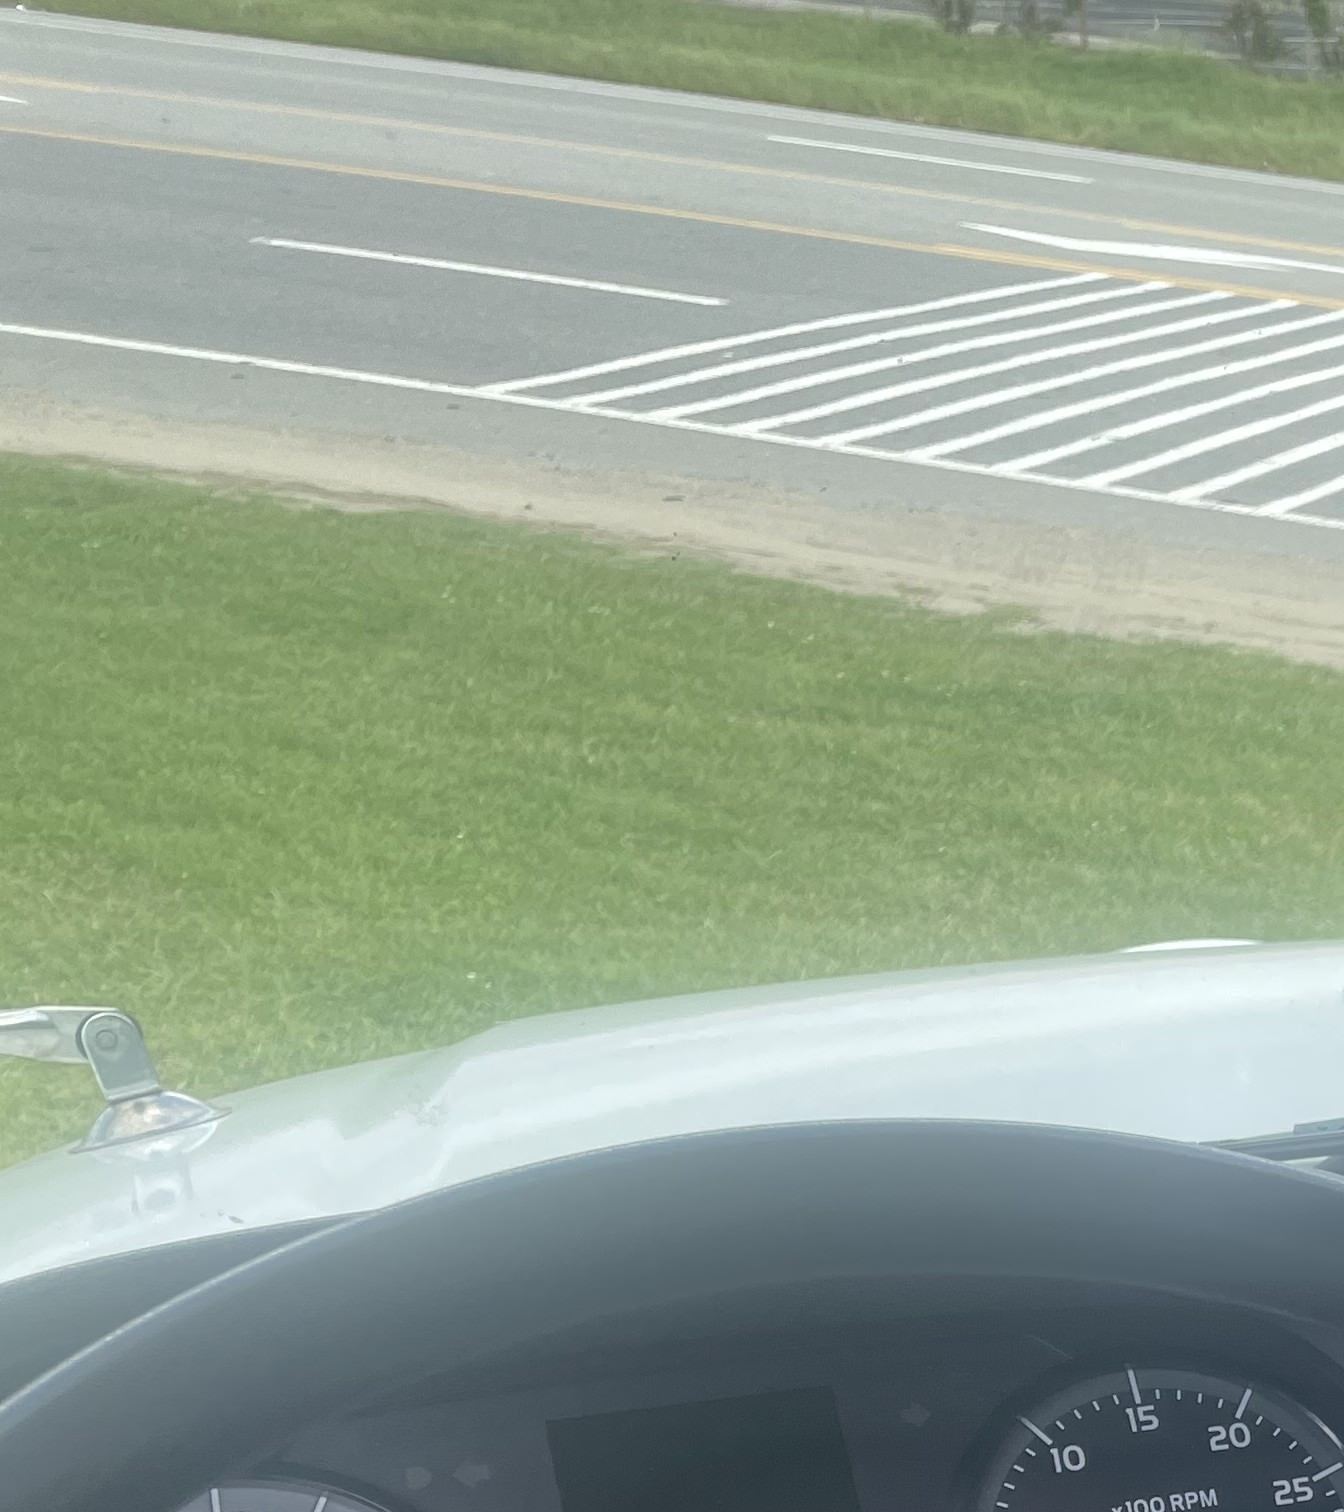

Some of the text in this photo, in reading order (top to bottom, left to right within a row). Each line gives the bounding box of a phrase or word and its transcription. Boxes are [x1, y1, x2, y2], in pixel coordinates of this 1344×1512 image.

[1126, 1403, 1160, 1433] 15
[1208, 1422, 1252, 1451] 20
[1049, 1444, 1087, 1473] 10
[1169, 1488, 1219, 1511] RPM
[1273, 1476, 1314, 1506] 25
